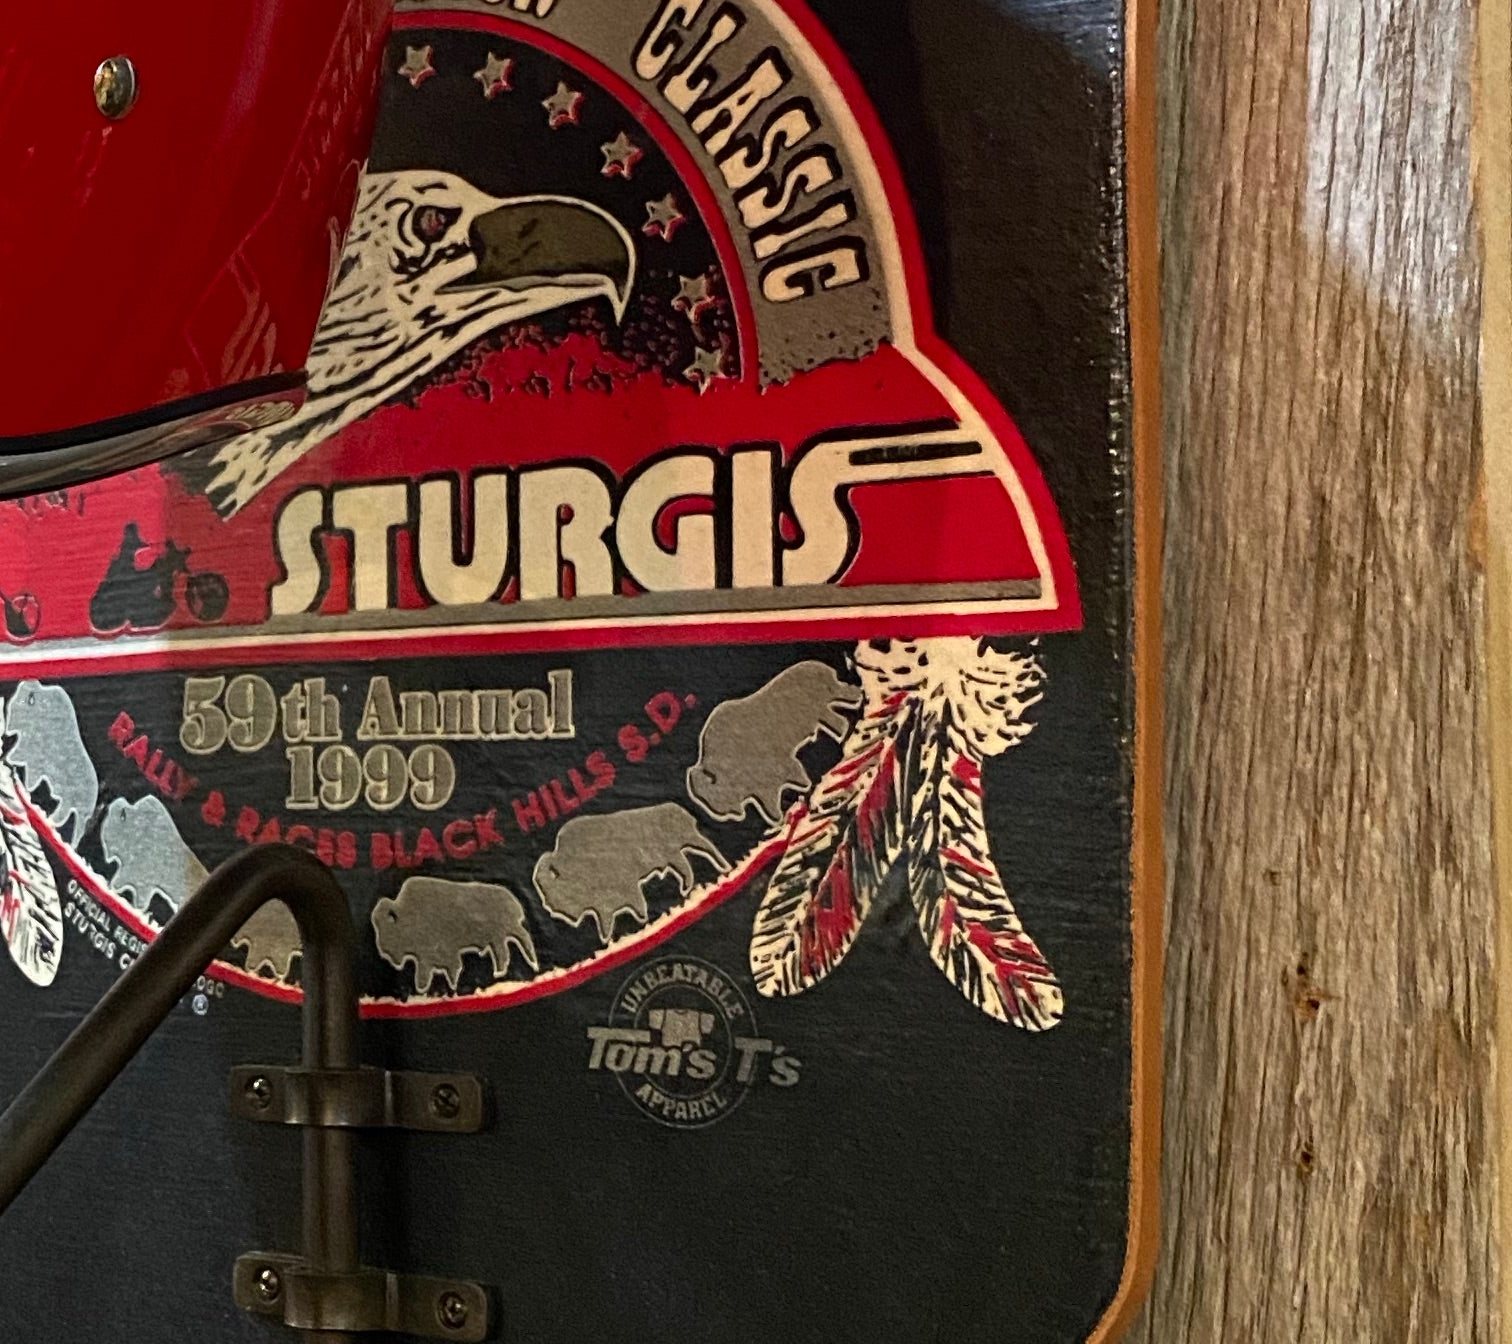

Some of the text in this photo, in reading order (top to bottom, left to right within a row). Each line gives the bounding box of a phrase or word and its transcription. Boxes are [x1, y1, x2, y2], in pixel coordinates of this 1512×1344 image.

[267, 429, 980, 618] STURGIS
[180, 669, 576, 754] 59th Annual
[108, 711, 198, 800] RALLY
[370, 808, 504, 870] BLACK
[511, 751, 616, 832] HILLS
[617, 690, 697, 763] S.D.
[285, 744, 455, 810] 1999
[64, 902, 117, 959] STURGIS
[67, 879, 110, 932] OFFICIAL
[621, 963, 745, 1019] UNBEATABLE
[587, 1026, 802, 1087] Tom's T's
[635, 1083, 728, 1120] APPAREL
